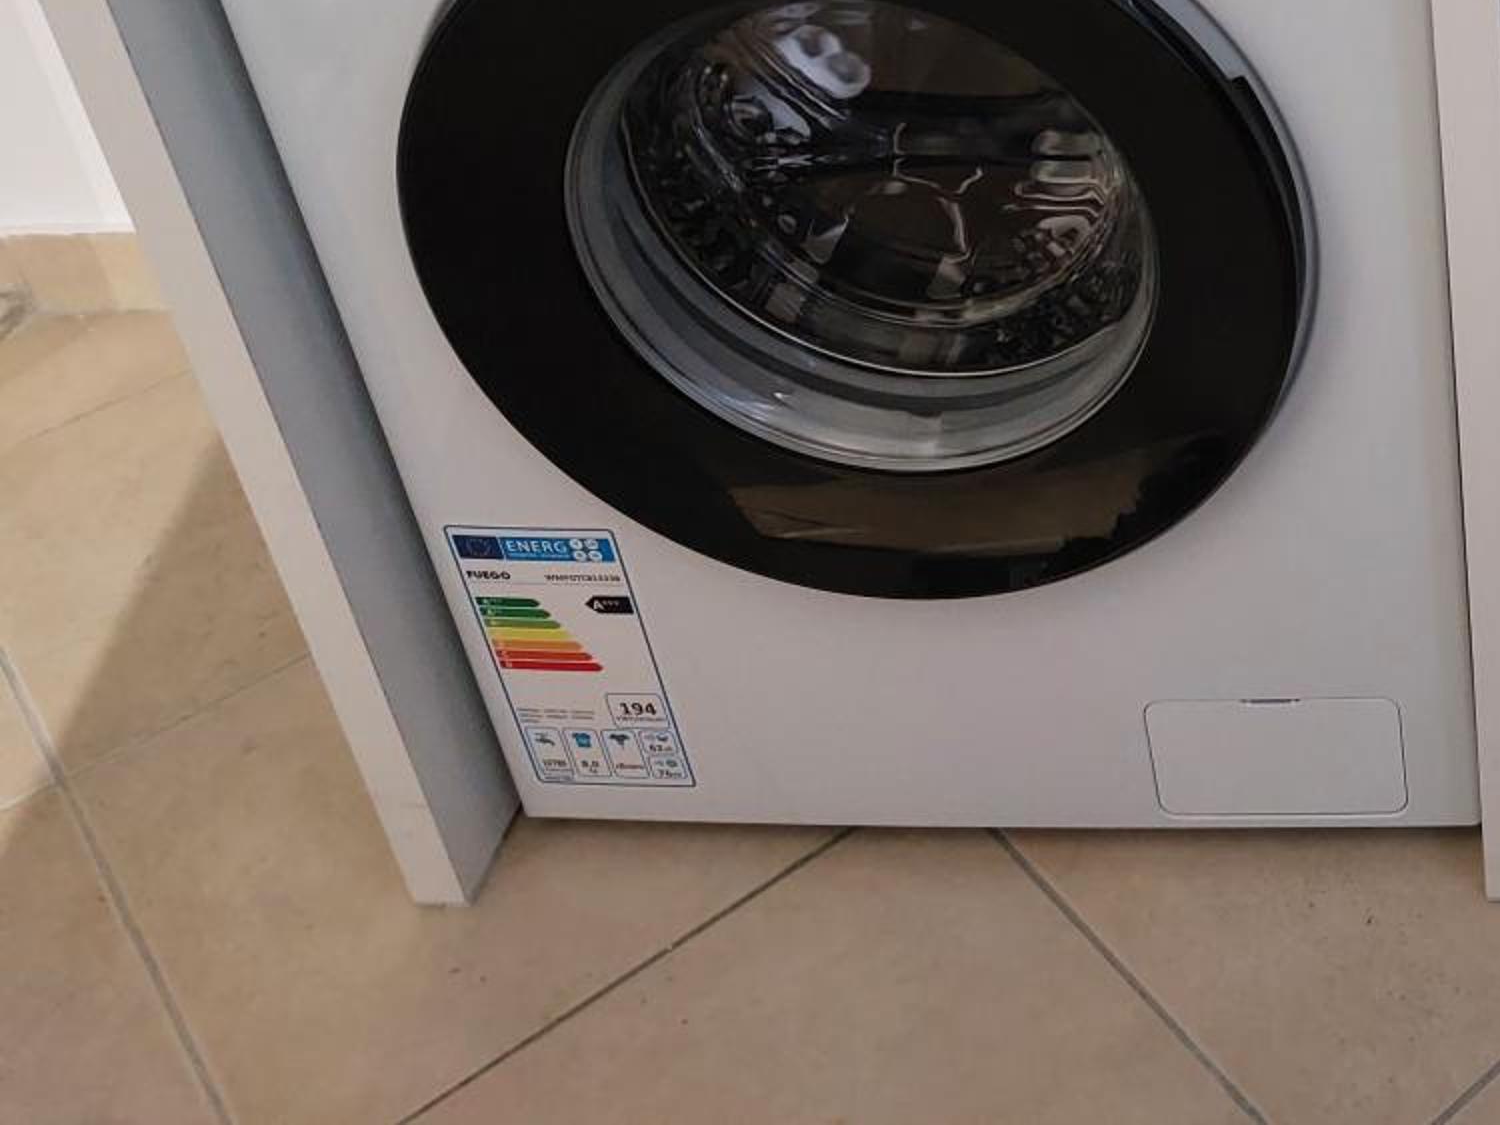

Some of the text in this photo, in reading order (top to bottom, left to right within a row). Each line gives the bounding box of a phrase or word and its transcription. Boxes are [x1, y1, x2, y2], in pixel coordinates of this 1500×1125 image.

[506, 539, 569, 554] ENERG
[466, 570, 511, 581] FUEGO
[619, 702, 657, 717] 194
